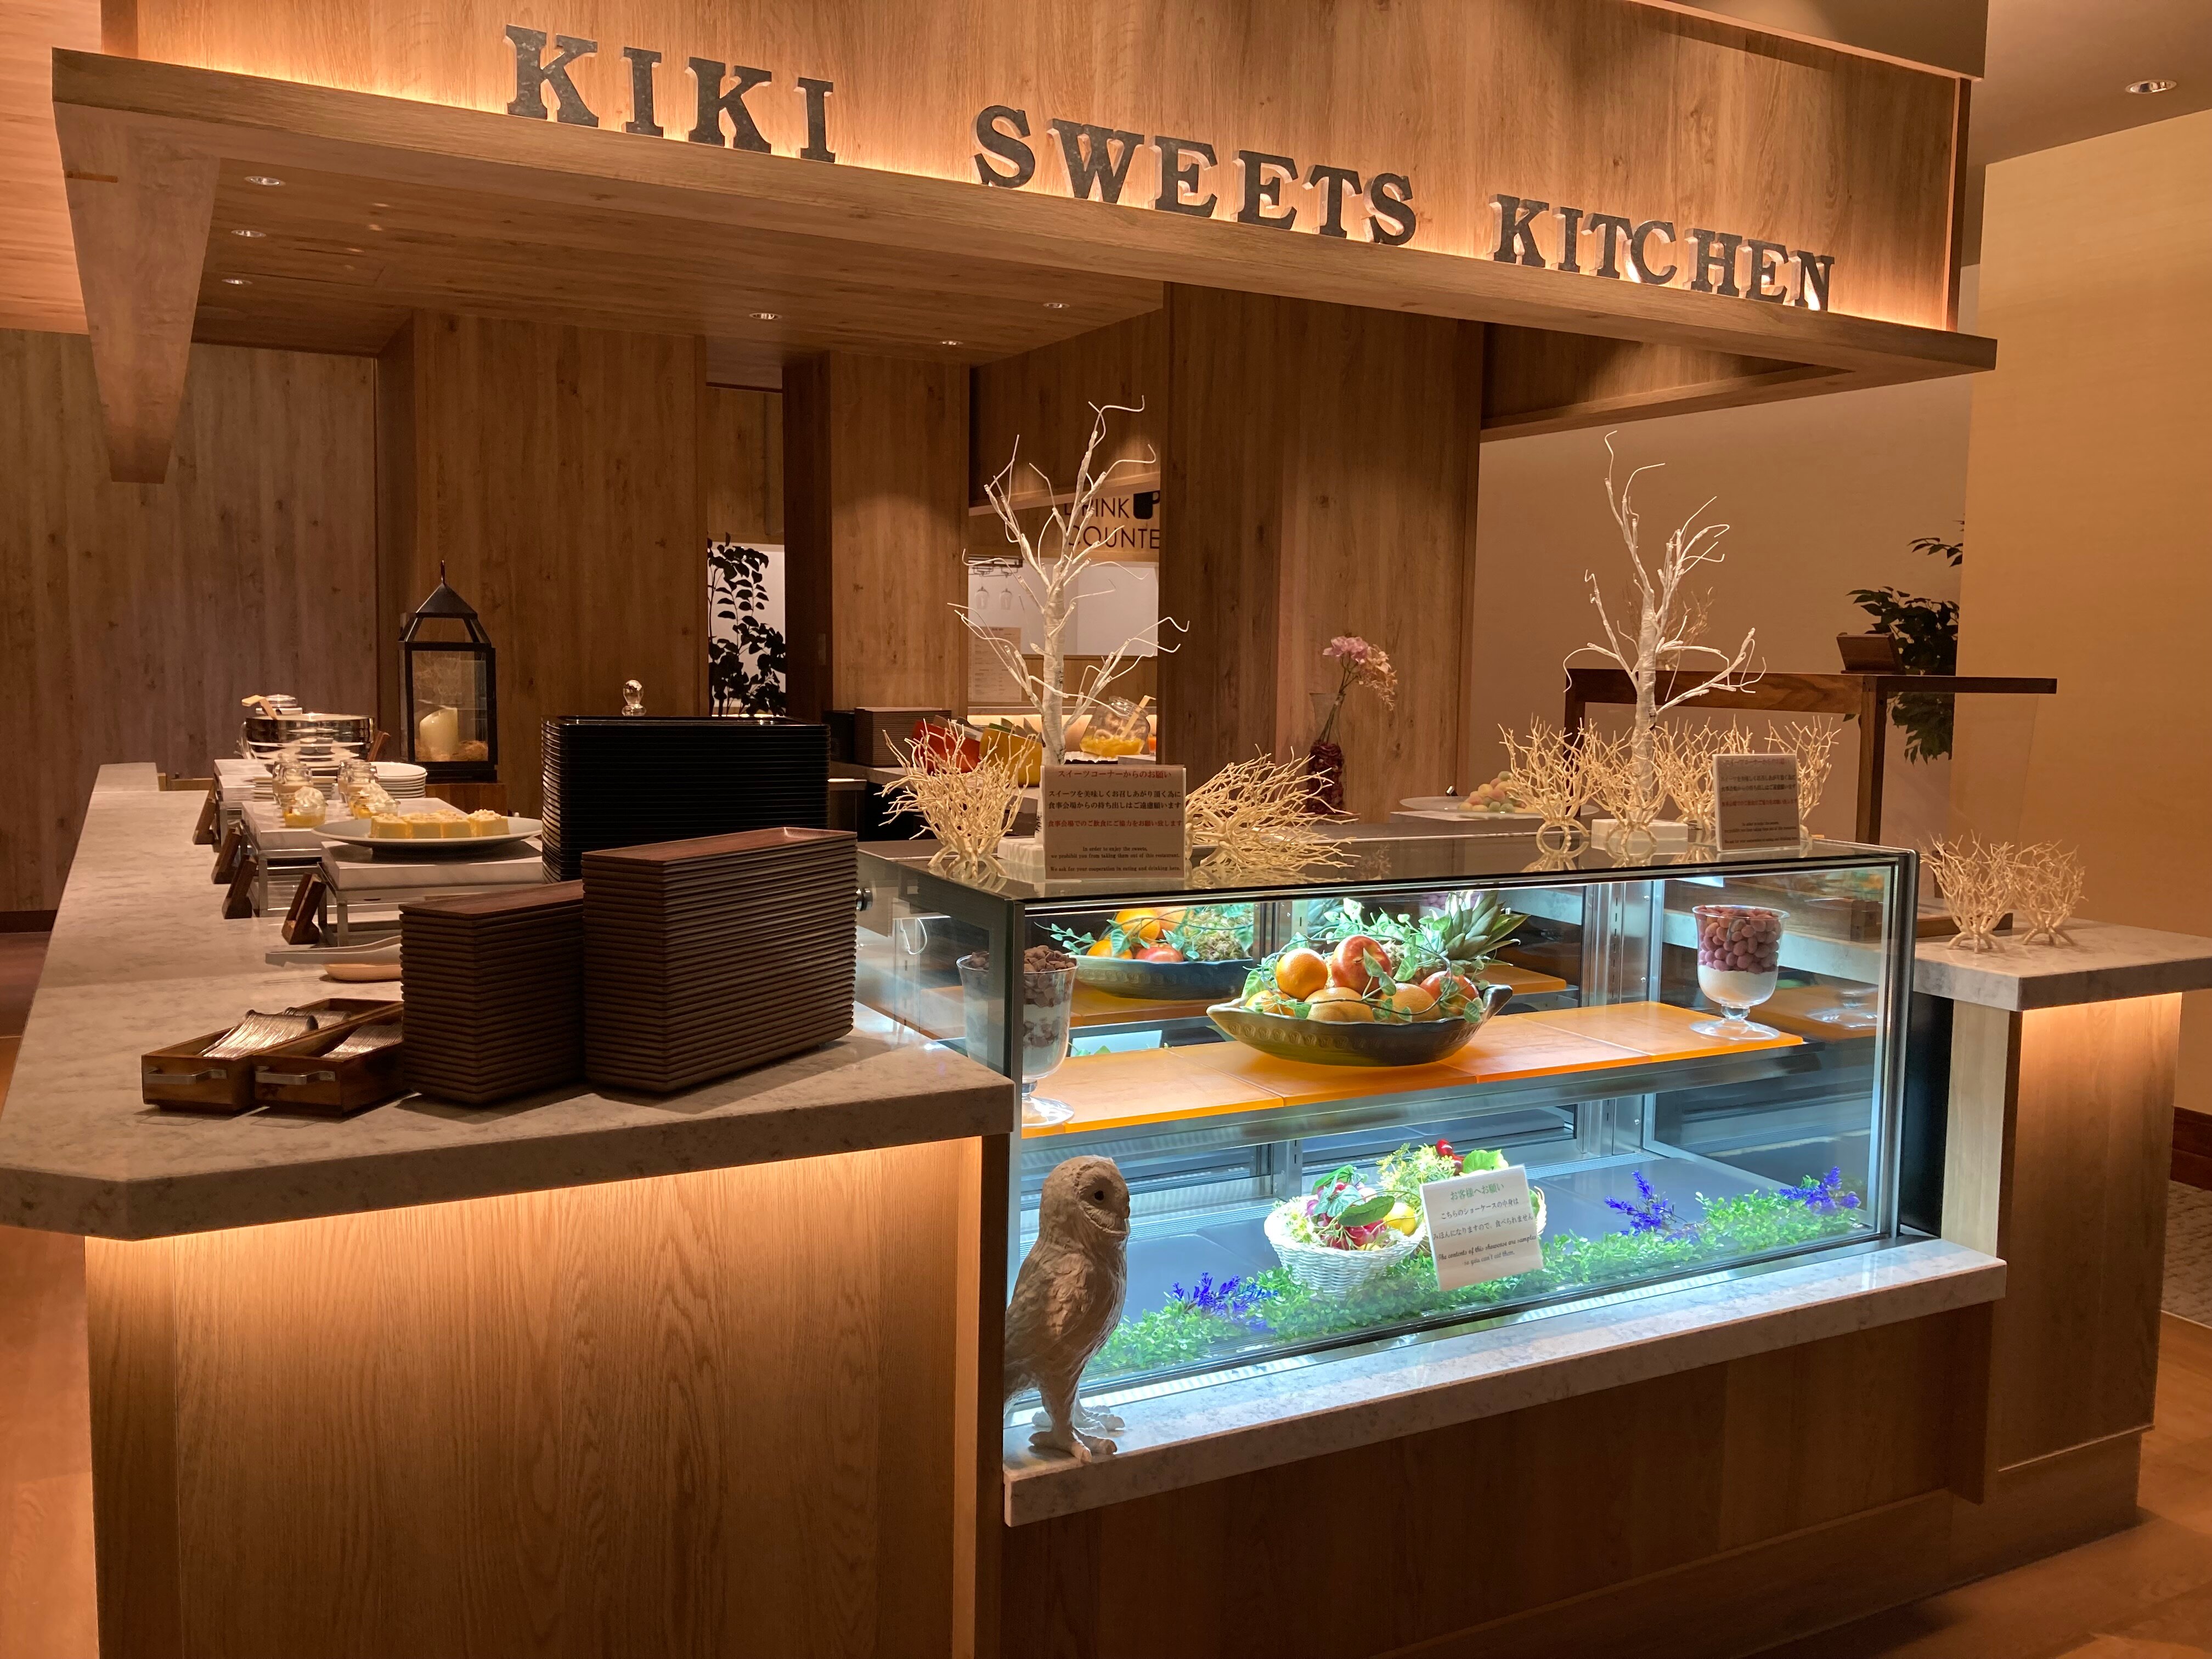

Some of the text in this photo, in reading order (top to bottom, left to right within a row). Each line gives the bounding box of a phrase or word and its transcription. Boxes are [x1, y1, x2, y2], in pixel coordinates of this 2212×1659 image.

[503, 24, 1835, 312] KIKI SWEETS KITCHEN
[1058, 770, 1171, 778] スイーツコーナーからのお願い
[1450, 1183, 1504, 1200] お客様へお願い
[1441, 1198, 1519, 1220] こちらのショーケースの中身は
[1437, 1253, 1447, 1261] The
[1448, 1250, 1468, 1259] contents
[1485, 1241, 1507, 1251] showcase
